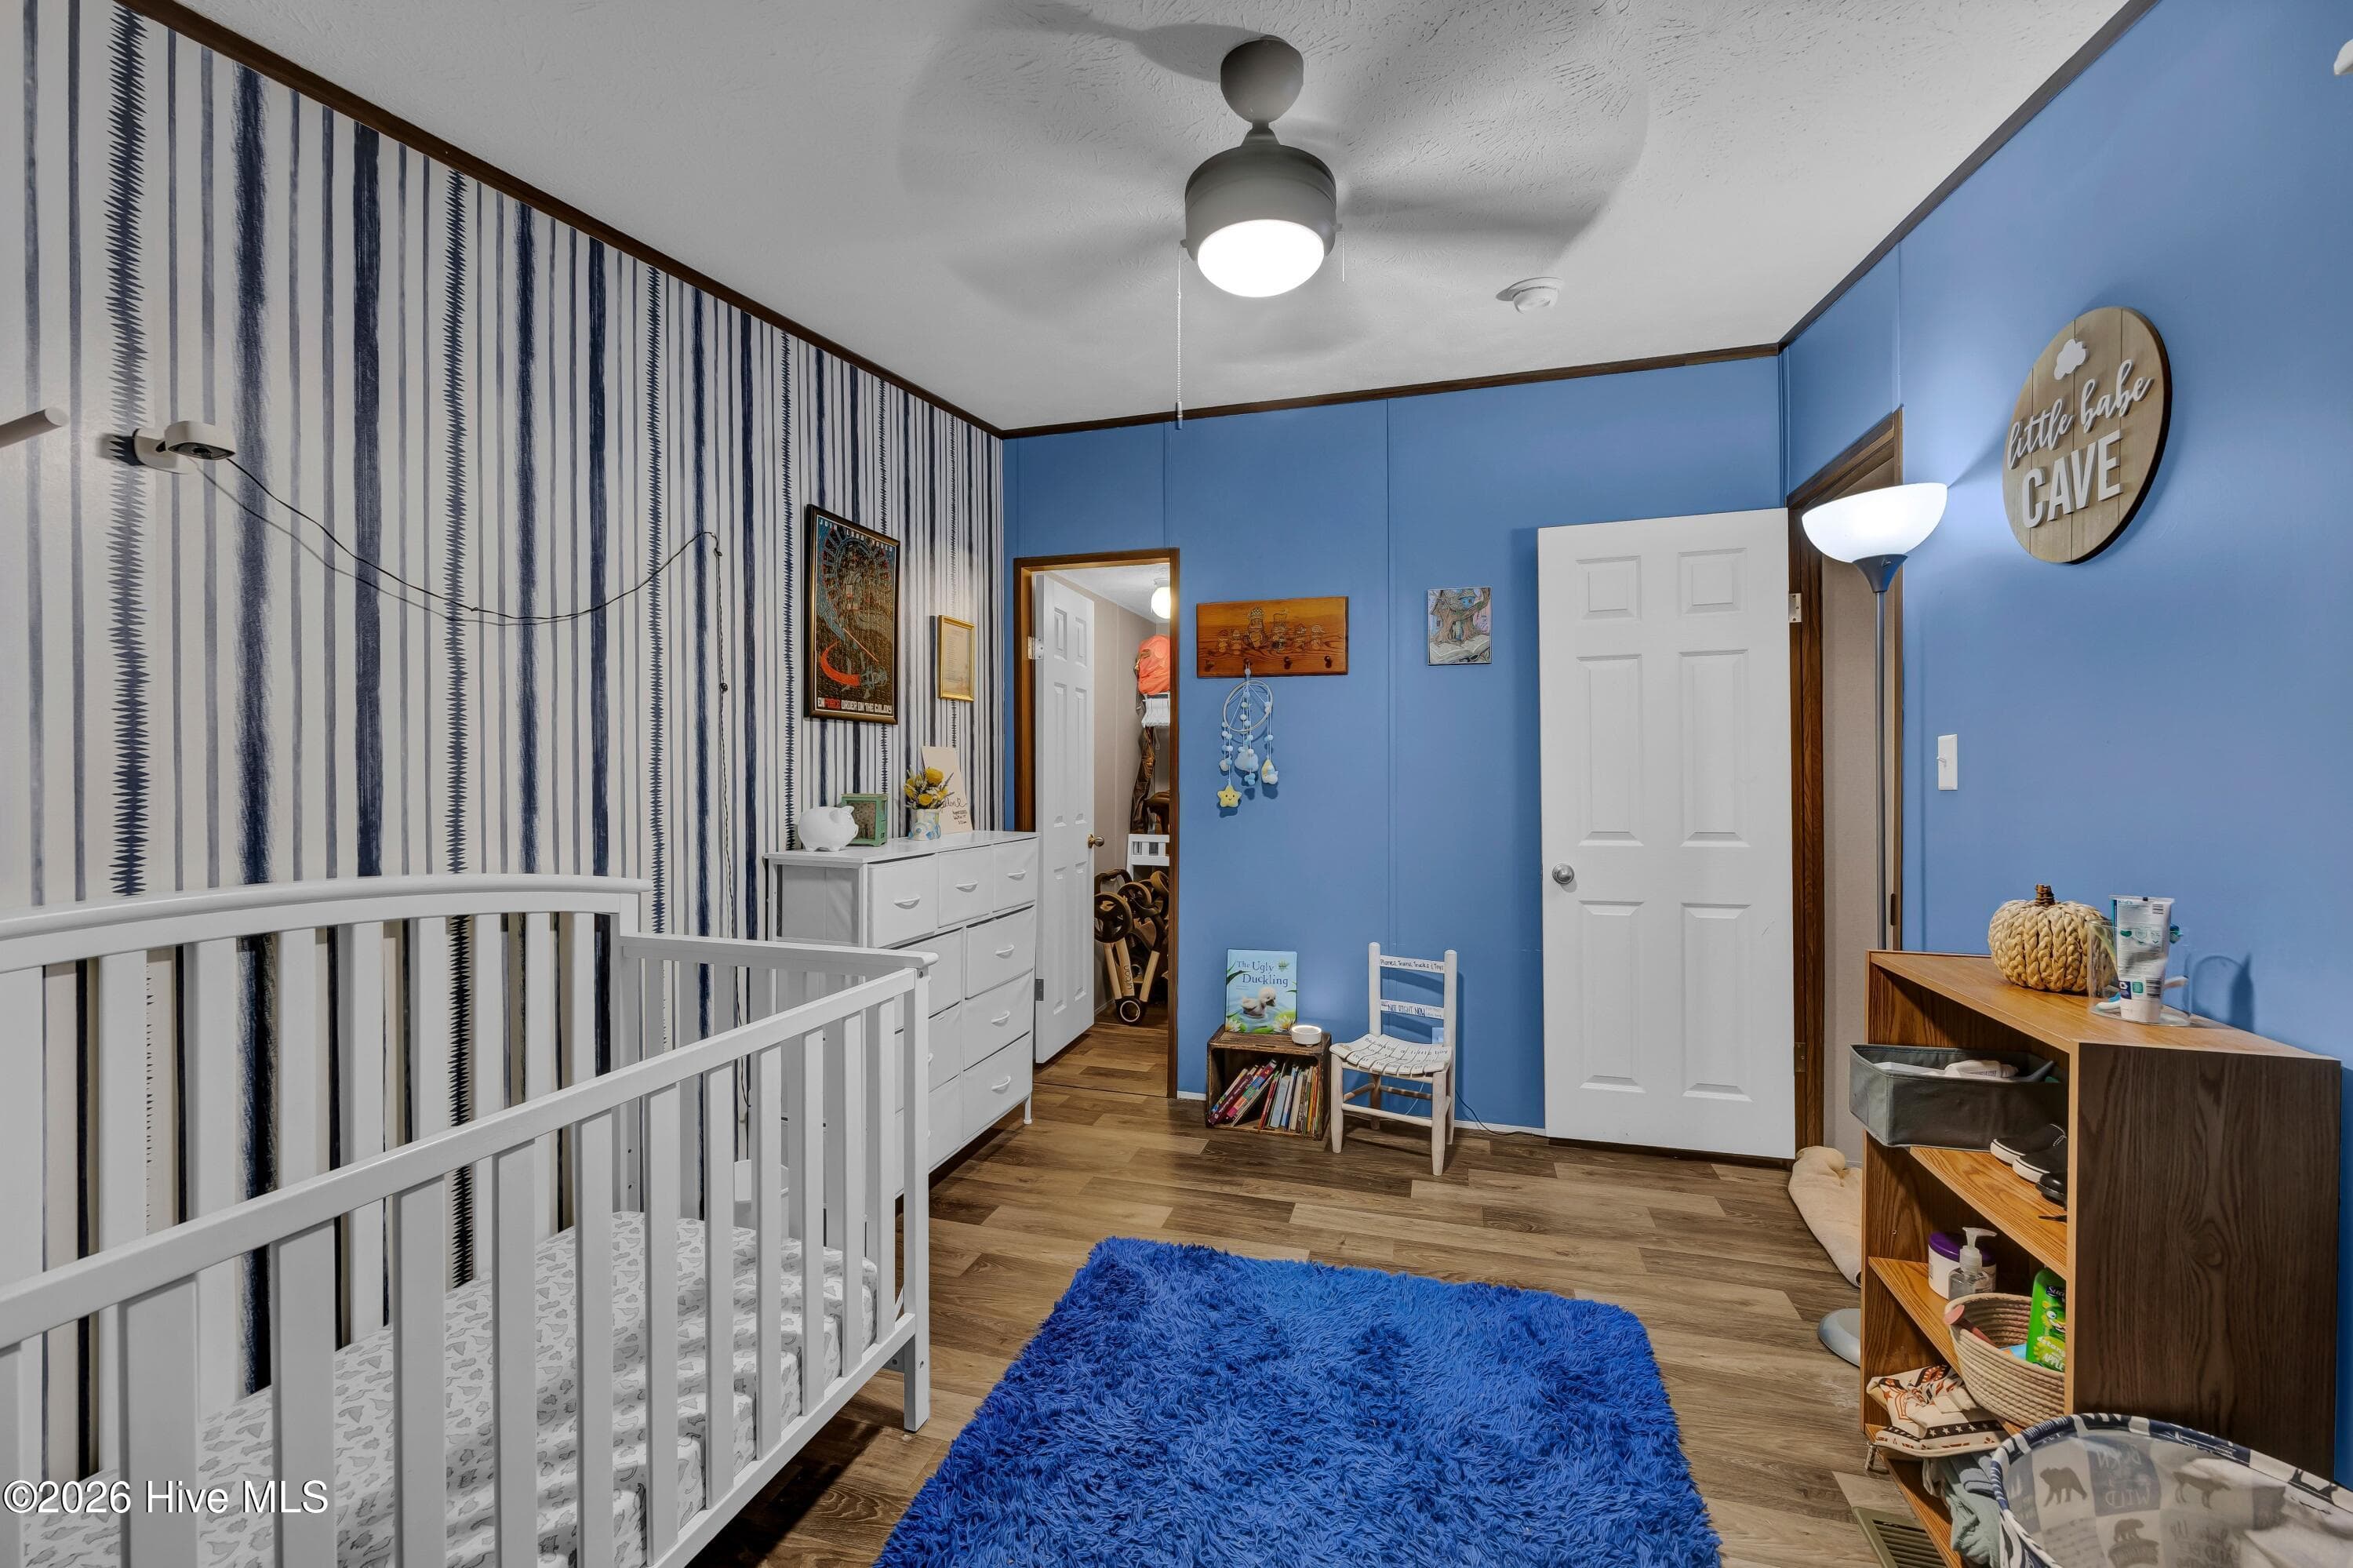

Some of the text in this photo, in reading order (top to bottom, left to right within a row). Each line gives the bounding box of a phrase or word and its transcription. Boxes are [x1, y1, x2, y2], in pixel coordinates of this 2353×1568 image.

[2007, 358, 2155, 471] little babe
[2022, 429, 2123, 529] CAVE
[1242, 973, 1289, 988] Duckling
[1253, 961, 1275, 973] Ugly
